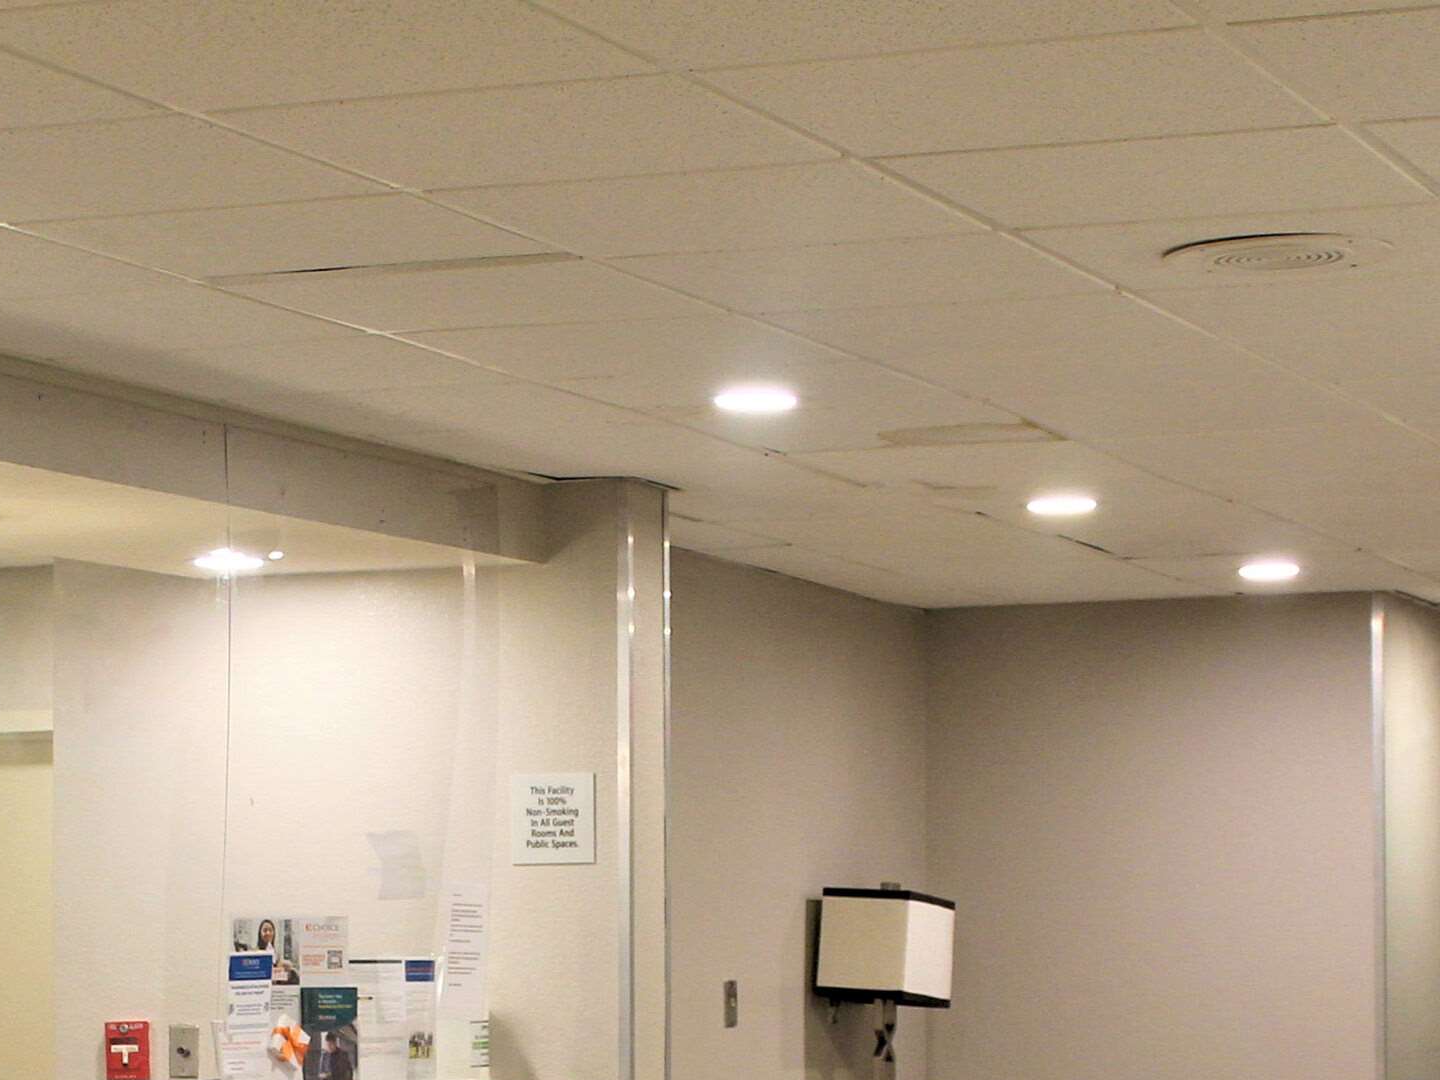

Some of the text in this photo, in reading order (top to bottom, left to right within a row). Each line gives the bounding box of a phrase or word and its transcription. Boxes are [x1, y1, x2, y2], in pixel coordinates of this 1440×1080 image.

[530, 786, 574, 796] This Facility
[547, 797, 567, 805] 100%
[526, 808, 579, 818] Non-Smoking
[540, 818, 550, 826] All
[552, 818, 574, 827] Guest
[531, 829, 575, 837] Rooms And
[526, 840, 549, 848] Public
